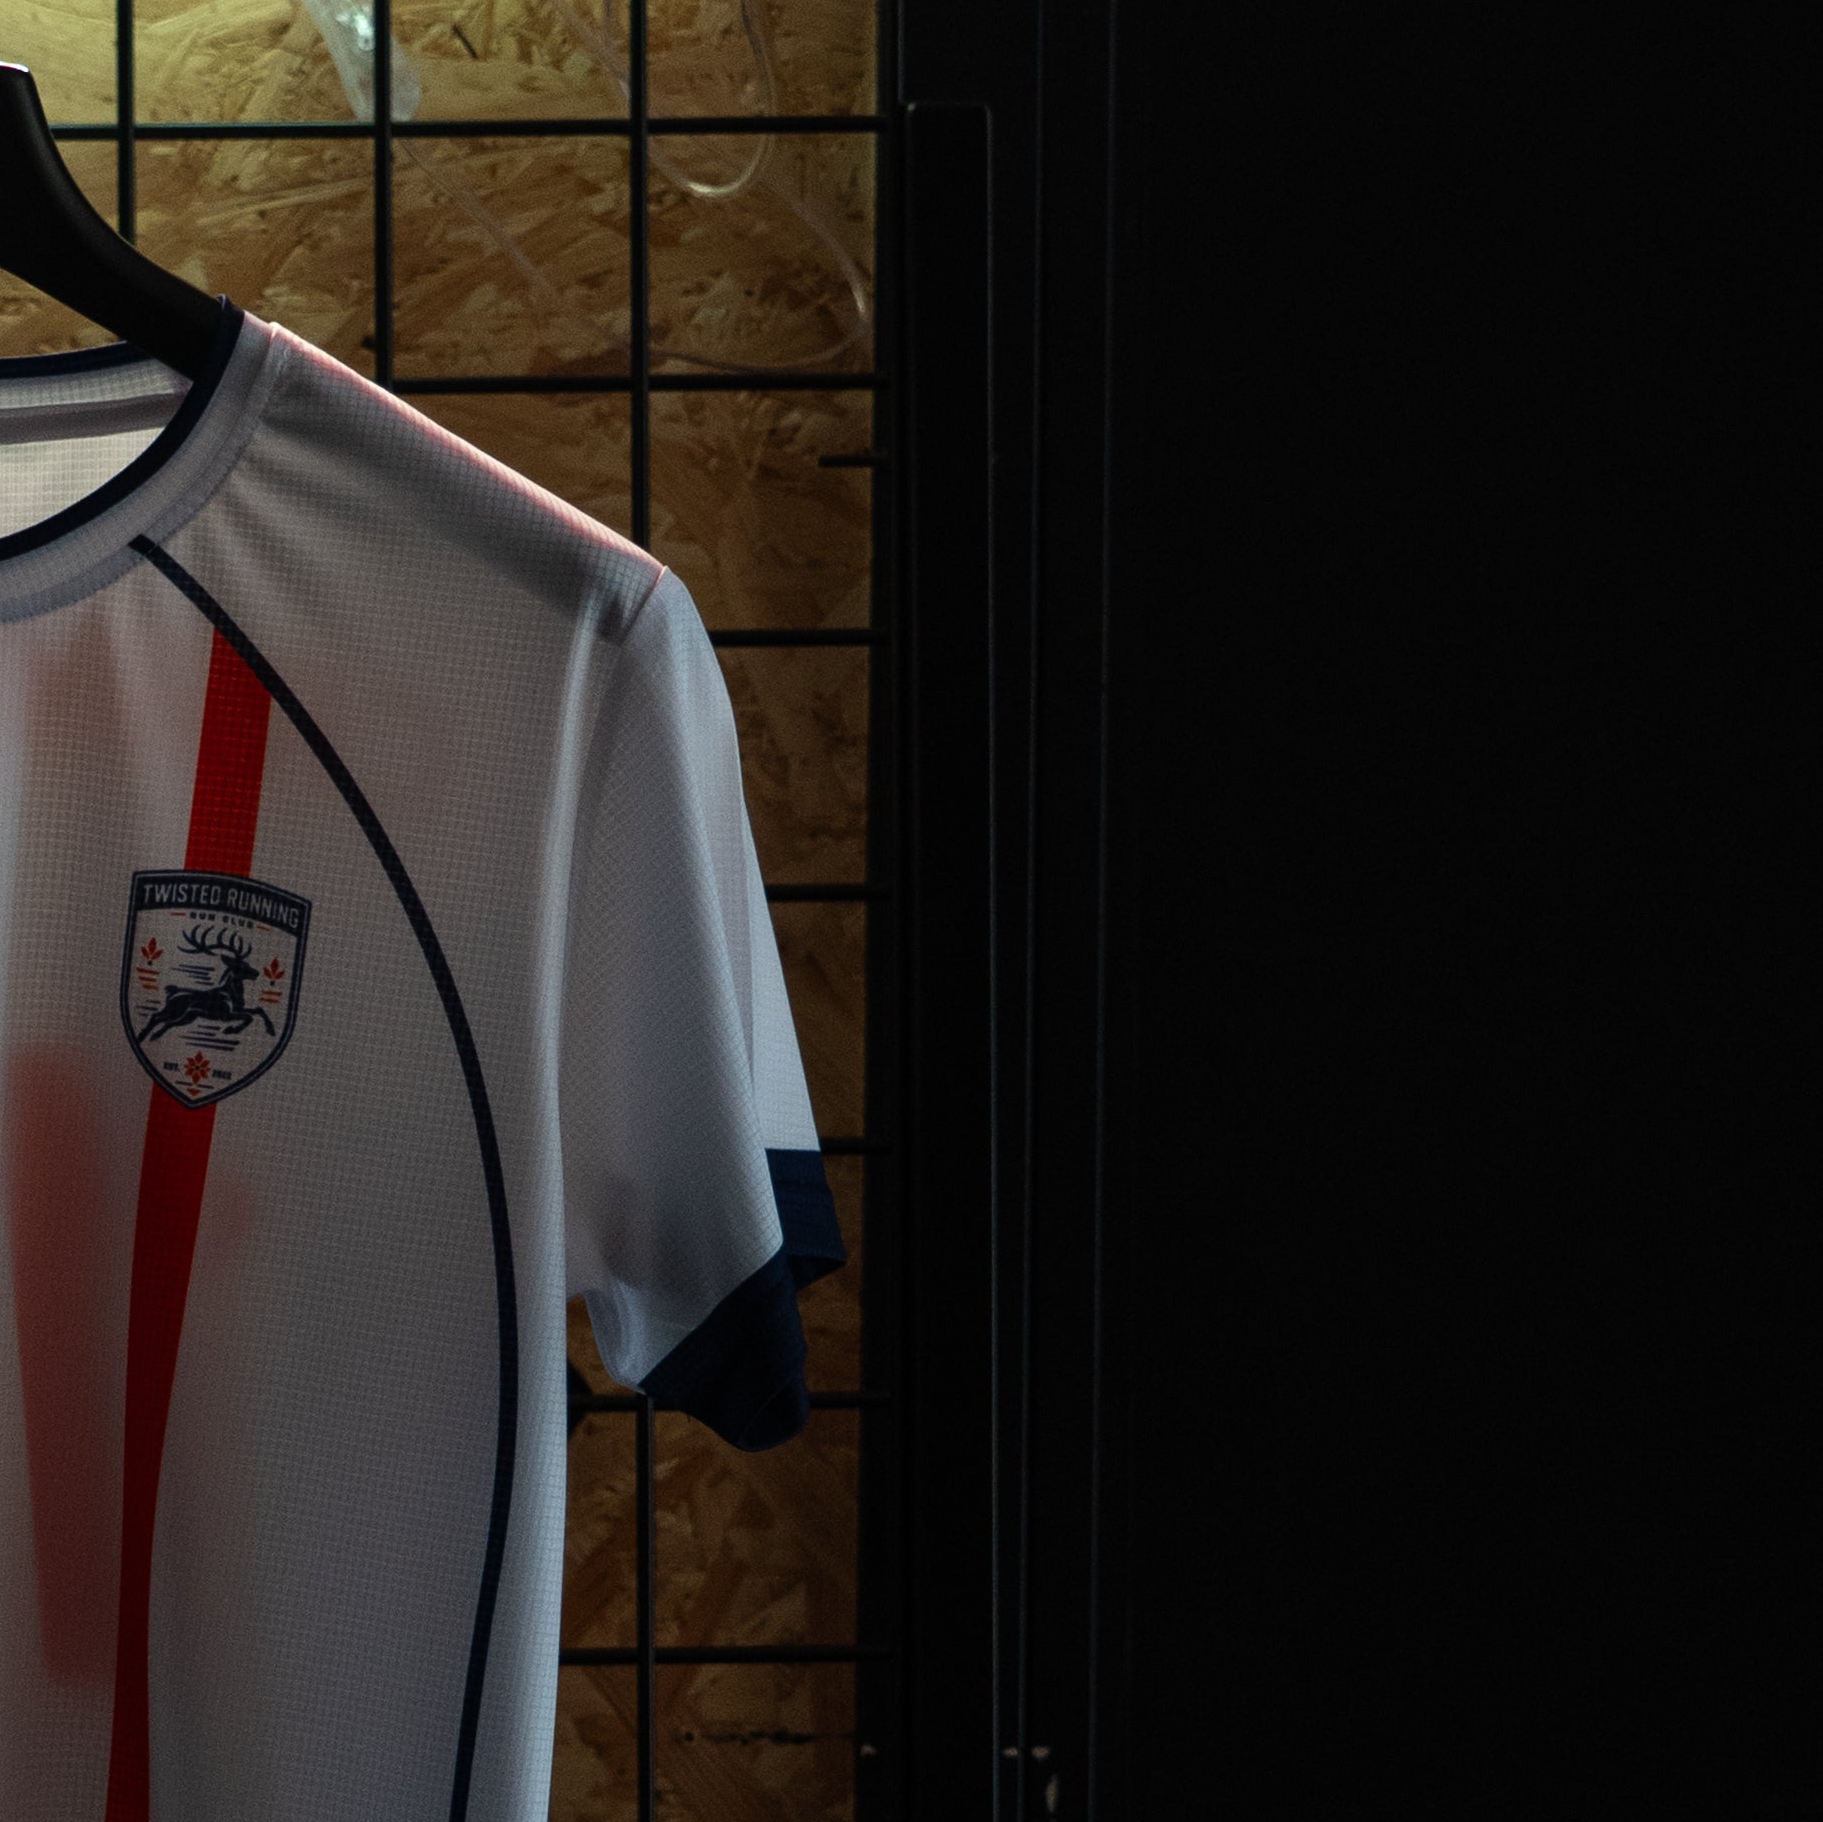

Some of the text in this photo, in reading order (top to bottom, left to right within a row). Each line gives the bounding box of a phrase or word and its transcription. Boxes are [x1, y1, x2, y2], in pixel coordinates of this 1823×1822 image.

[142, 883, 300, 930] TWISTED RUNNING
[189, 911, 254, 929] RUN CLUB
